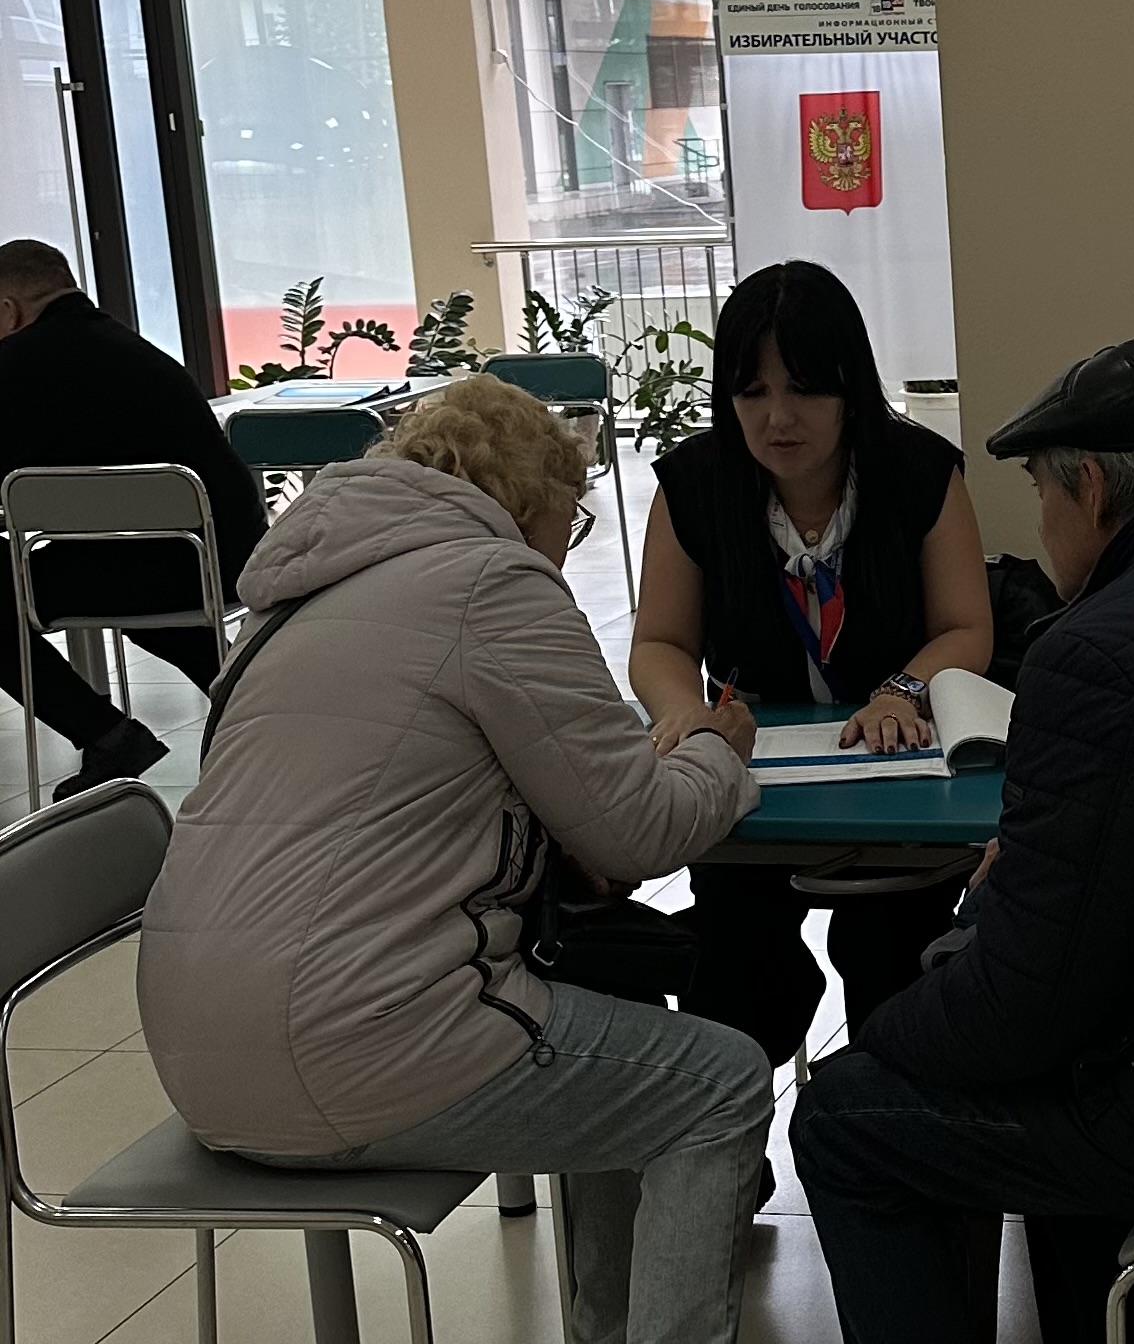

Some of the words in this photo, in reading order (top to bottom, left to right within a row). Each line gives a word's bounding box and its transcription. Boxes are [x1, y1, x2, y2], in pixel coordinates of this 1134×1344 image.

[728, 2, 765, 13] ЕДИНЫЙ
[767, 3, 791, 12] ДЕНЬ
[794, 1, 860, 11] ГОЛОСОВАНИЯ
[818, 17, 924, 28] ИНФОРМАЦИОННЫЙ
[729, 29, 872, 48] ИЗБИРАТЕЛЬНЫЙ
